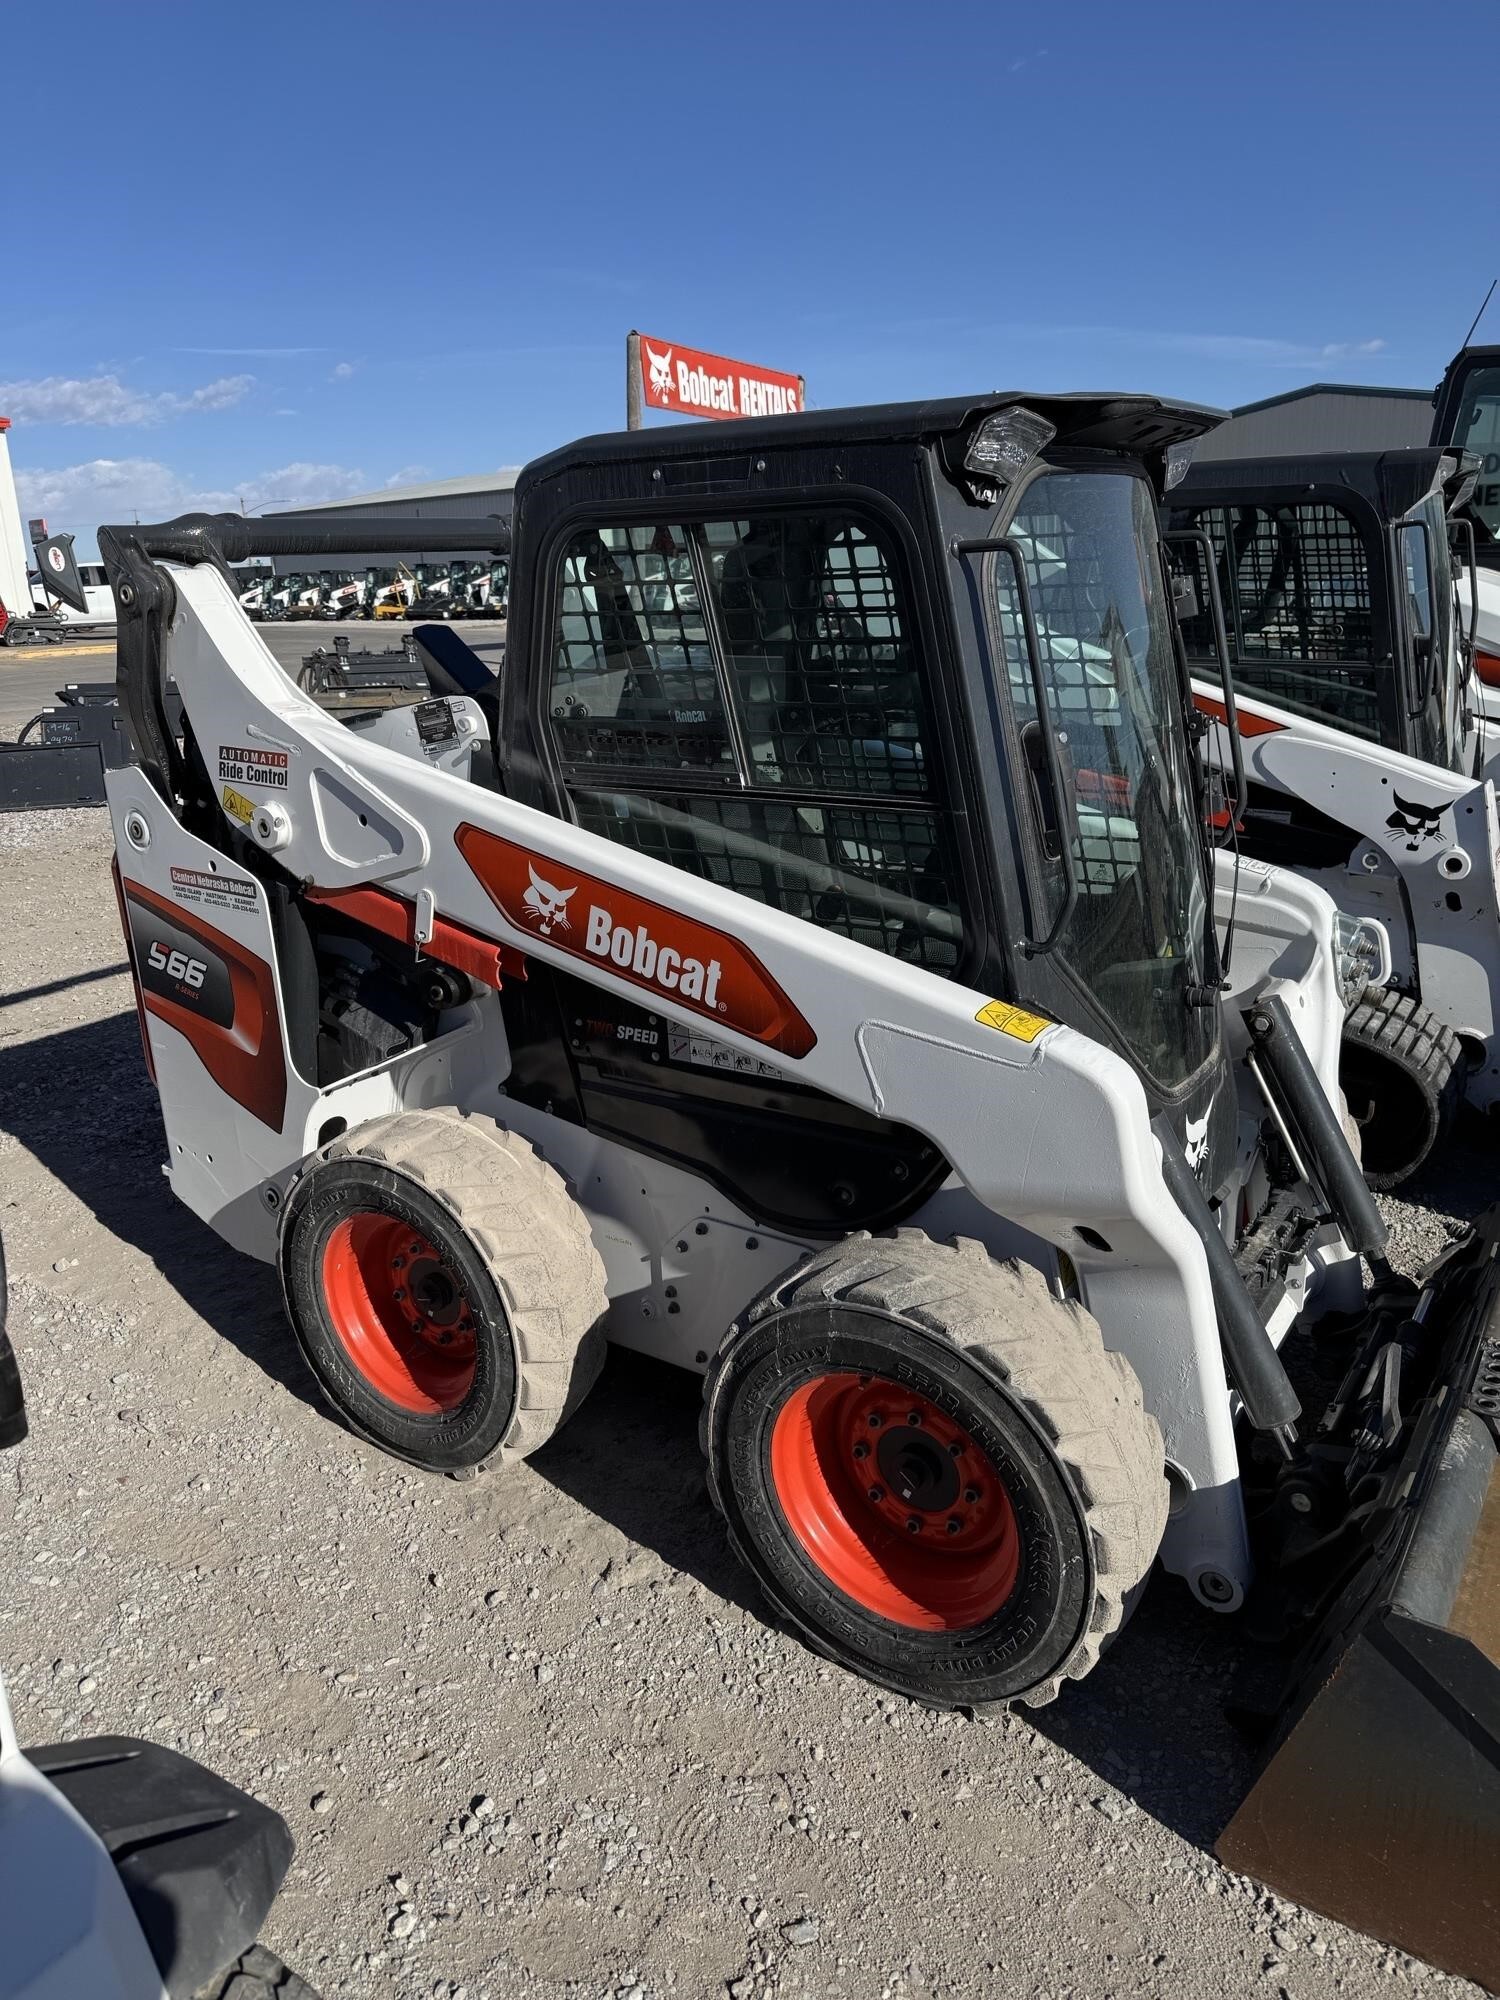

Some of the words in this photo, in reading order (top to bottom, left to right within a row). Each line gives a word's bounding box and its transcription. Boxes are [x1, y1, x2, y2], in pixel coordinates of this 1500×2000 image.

[676, 360, 735, 413] Bobcat
[739, 377, 797, 416] RENTALS
[221, 748, 286, 767] AUTOMATIC
[219, 761, 243, 780] Ride
[246, 765, 288, 787] Control
[172, 870, 197, 885] Central
[197, 874, 229, 892] Nebraska
[229, 881, 255, 897] Bobcat
[148, 941, 208, 989] S66
[585, 903, 722, 1009] Bobcat
[616, 1025, 659, 1045] SPEED
